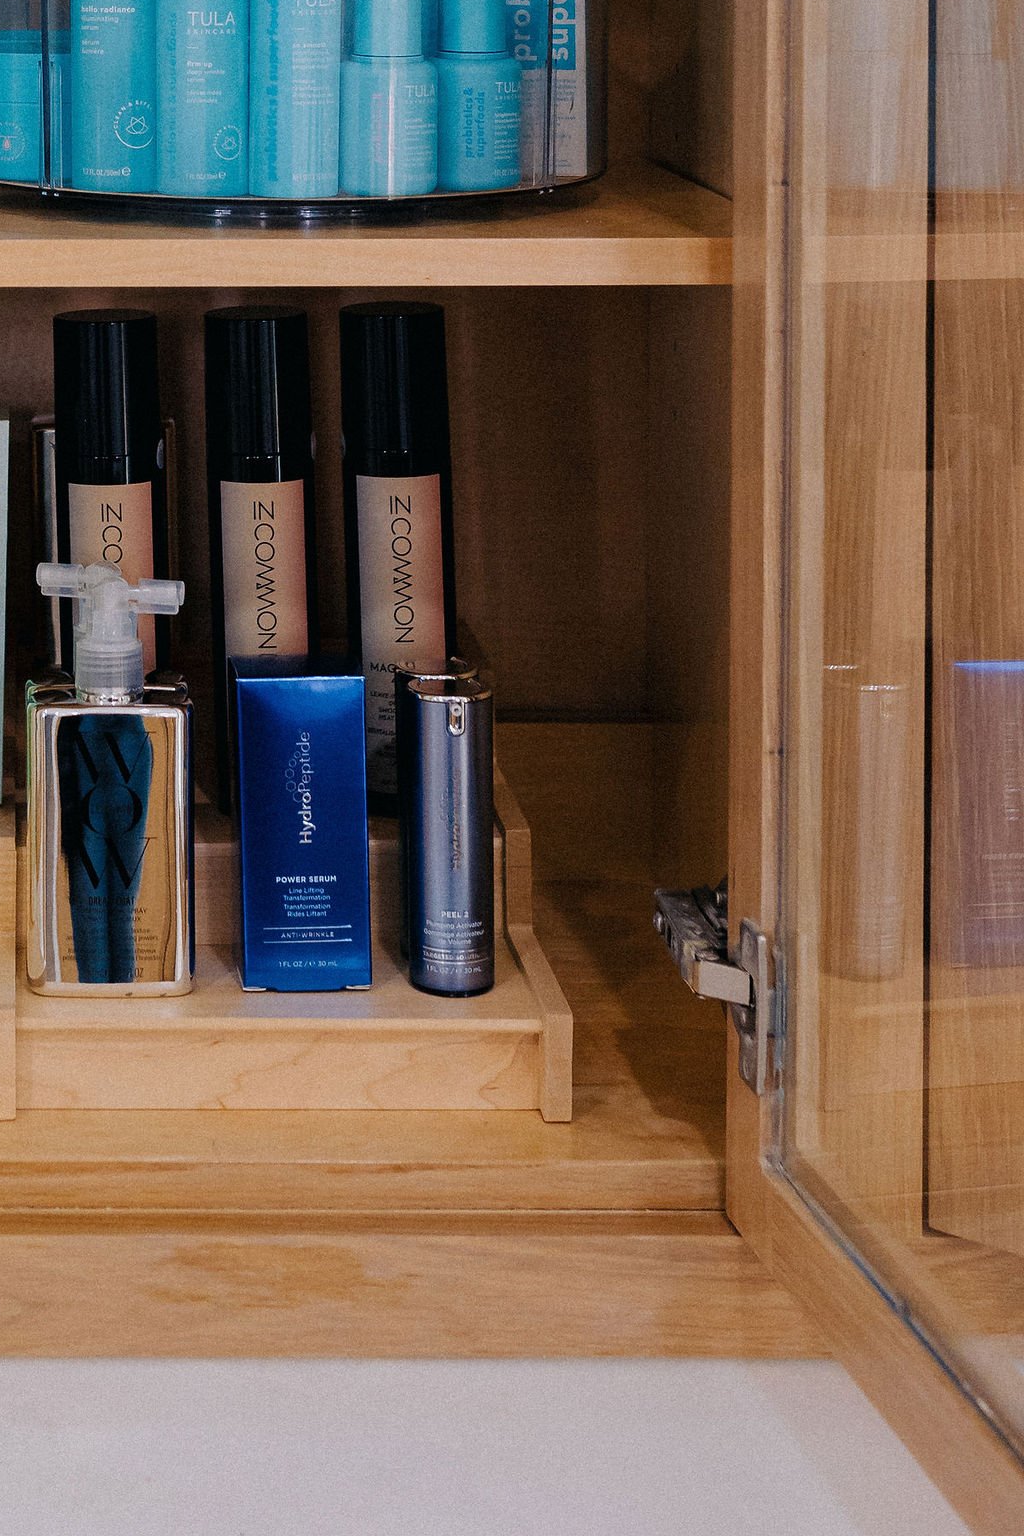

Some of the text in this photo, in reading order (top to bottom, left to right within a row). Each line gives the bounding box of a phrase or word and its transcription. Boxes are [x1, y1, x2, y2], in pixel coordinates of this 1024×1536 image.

[100, 5, 135, 13] radiance
[187, 10, 236, 26] TULA
[101, 503, 123, 562] INCO
[253, 500, 277, 649] INCOMMON
[390, 495, 415, 644] INCOMMON
[297, 731, 317, 844] HydroPeptide
[276, 875, 337, 883] POWER SERUM
[281, 931, 335, 939] ANTI-WRINKLE
